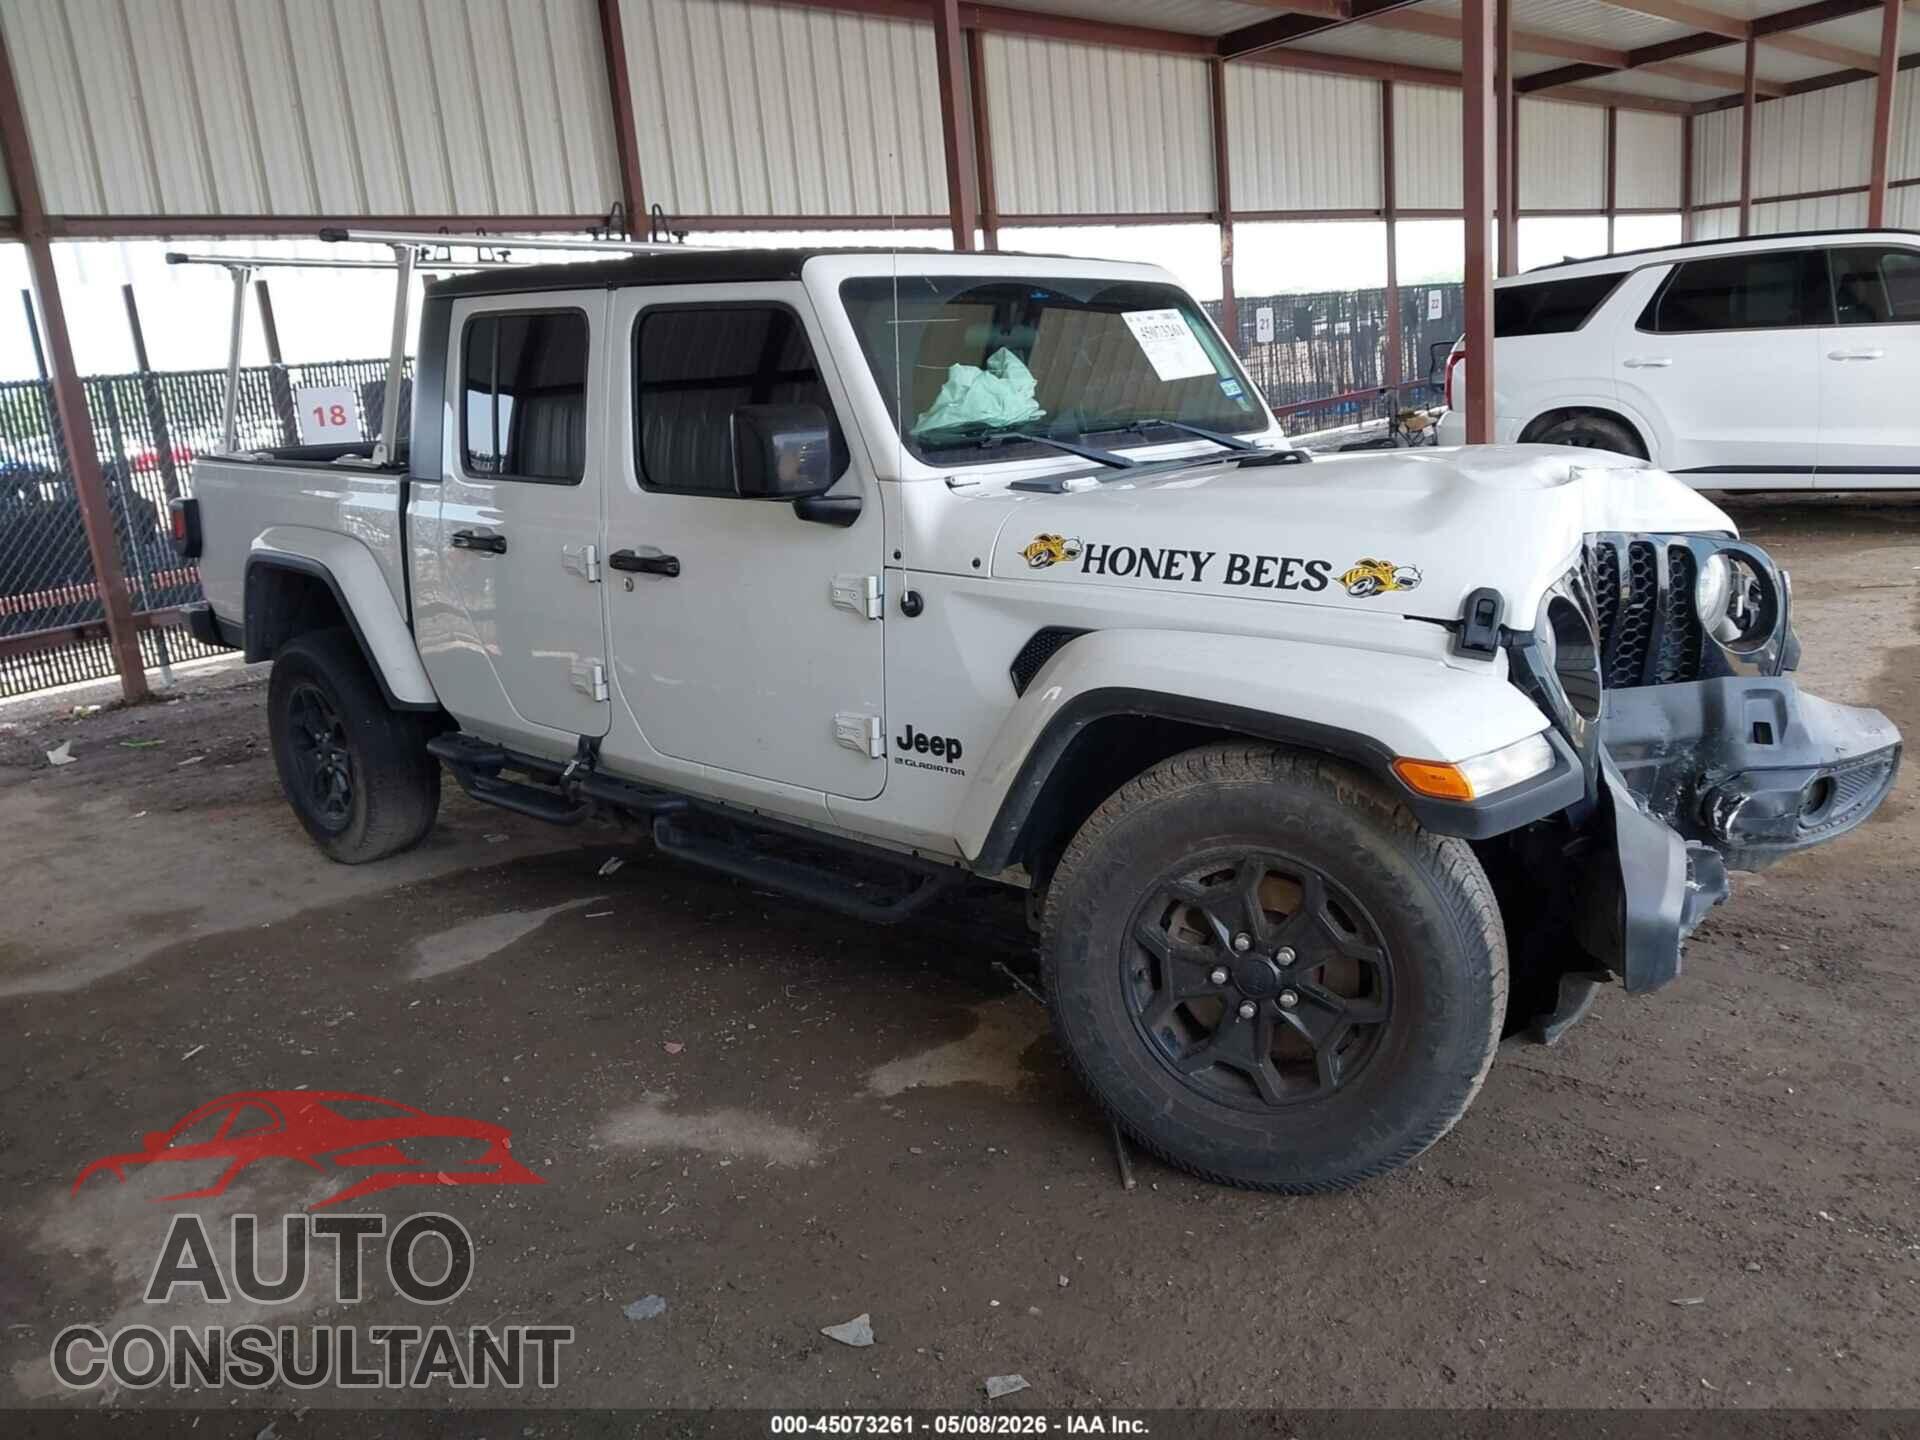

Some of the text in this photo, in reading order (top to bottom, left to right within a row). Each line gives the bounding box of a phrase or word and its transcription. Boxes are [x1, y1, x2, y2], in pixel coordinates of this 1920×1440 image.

[1259, 318, 1270, 330] 21
[313, 405, 346, 427] 18
[1081, 543, 1332, 592] HONEY BEES
[896, 724, 962, 763] Jeep
[904, 758, 966, 777] GLADIATOR
